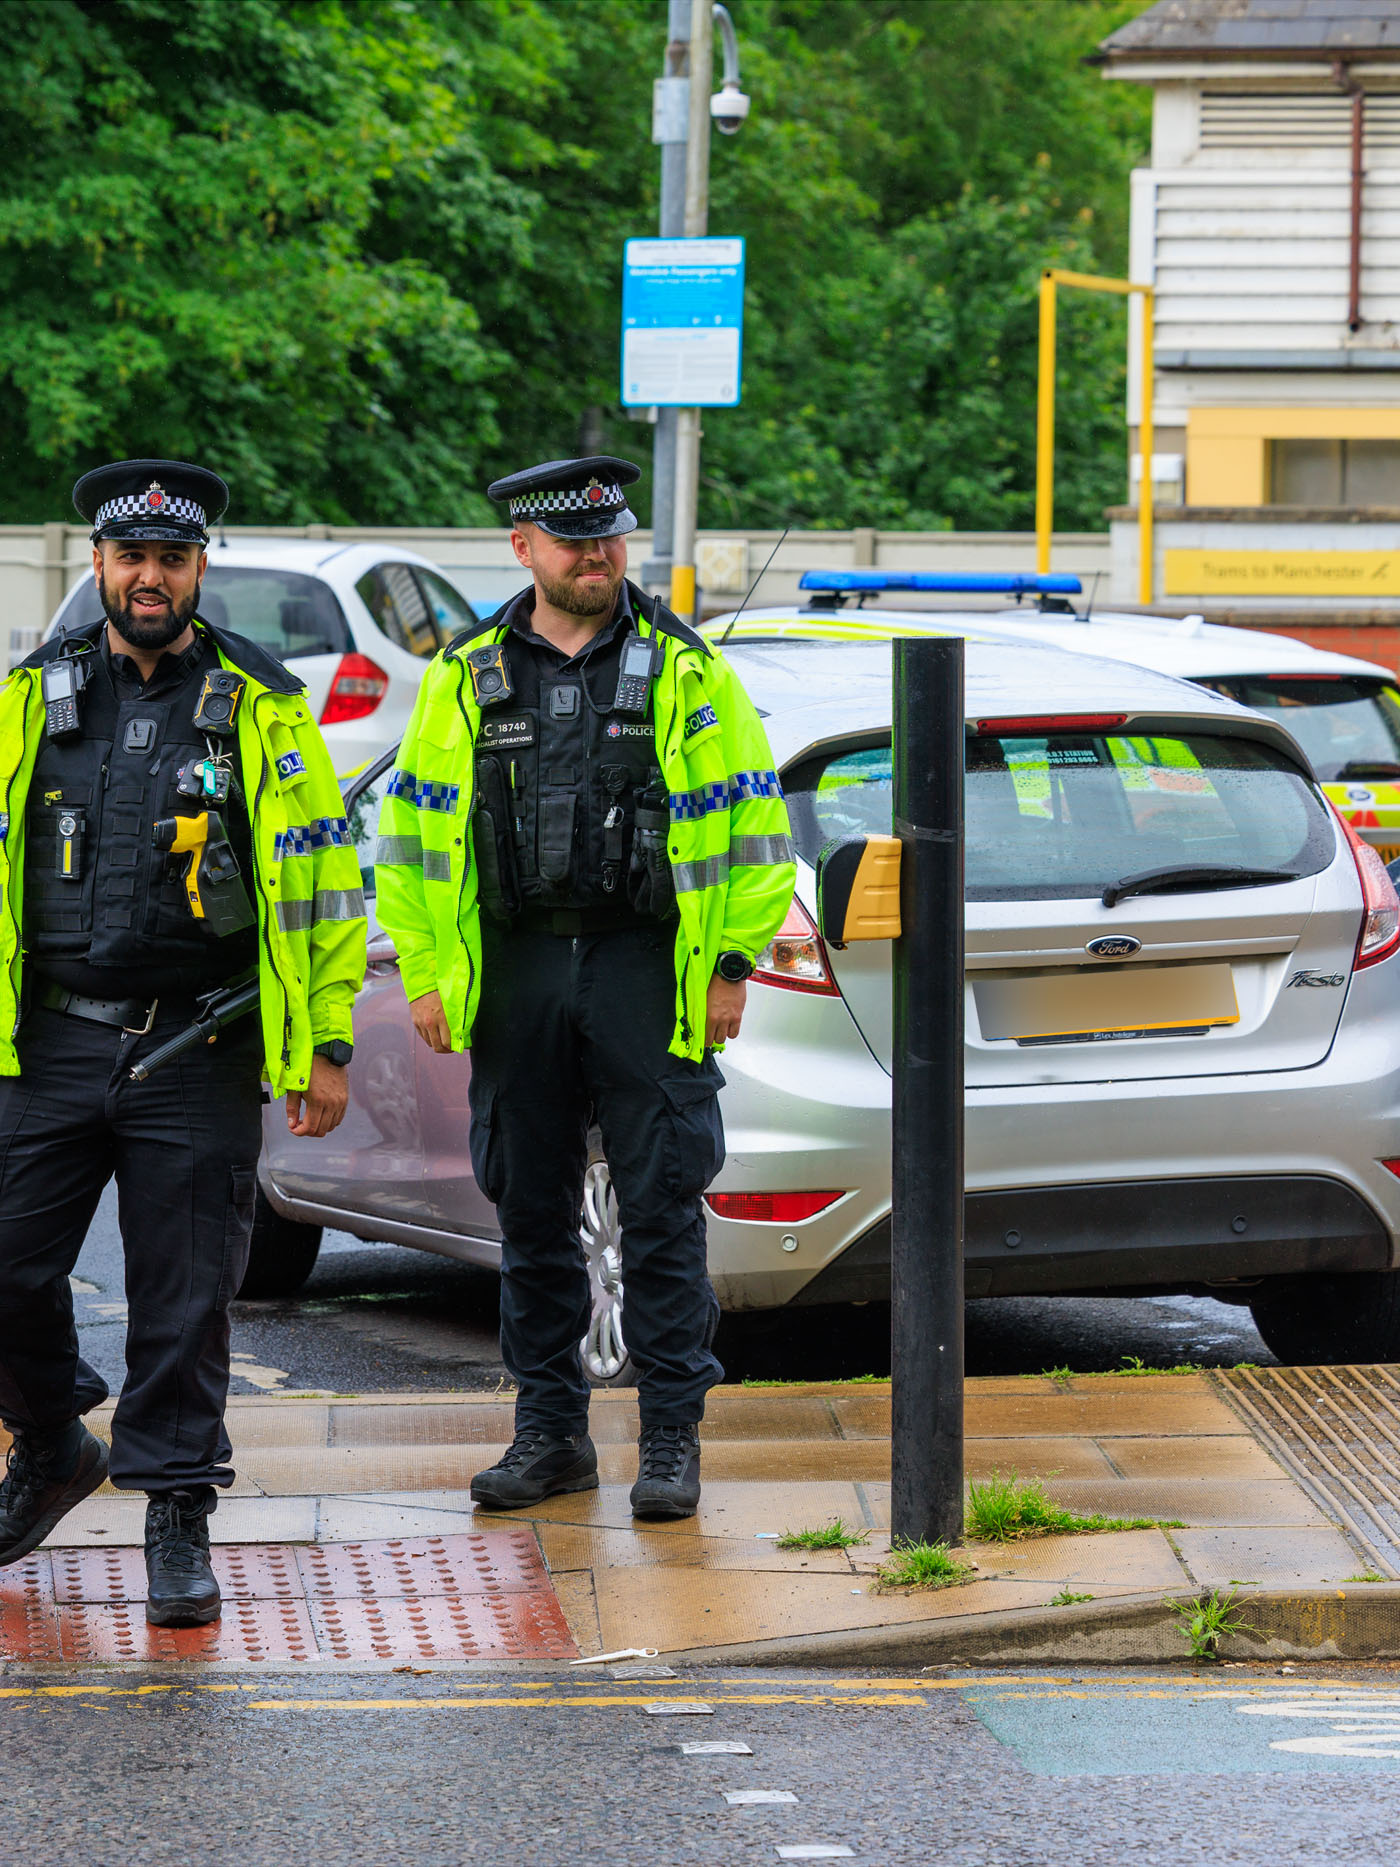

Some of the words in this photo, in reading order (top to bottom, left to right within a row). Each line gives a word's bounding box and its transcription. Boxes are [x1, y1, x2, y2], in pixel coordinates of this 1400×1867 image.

[1203, 563, 1249, 578] Trams
[1251, 564, 1270, 578] to
[1272, 563, 1365, 578] Manchester
[498, 722, 527, 733] 18740
[684, 708, 716, 736] POLIC
[622, 727, 655, 736] POLICE
[498, 735, 533, 745] OPERATIONS
[278, 754, 305, 774] OLI
[1098, 940, 1130, 954] Ford
[1285, 968, 1345, 988] Fiesta
